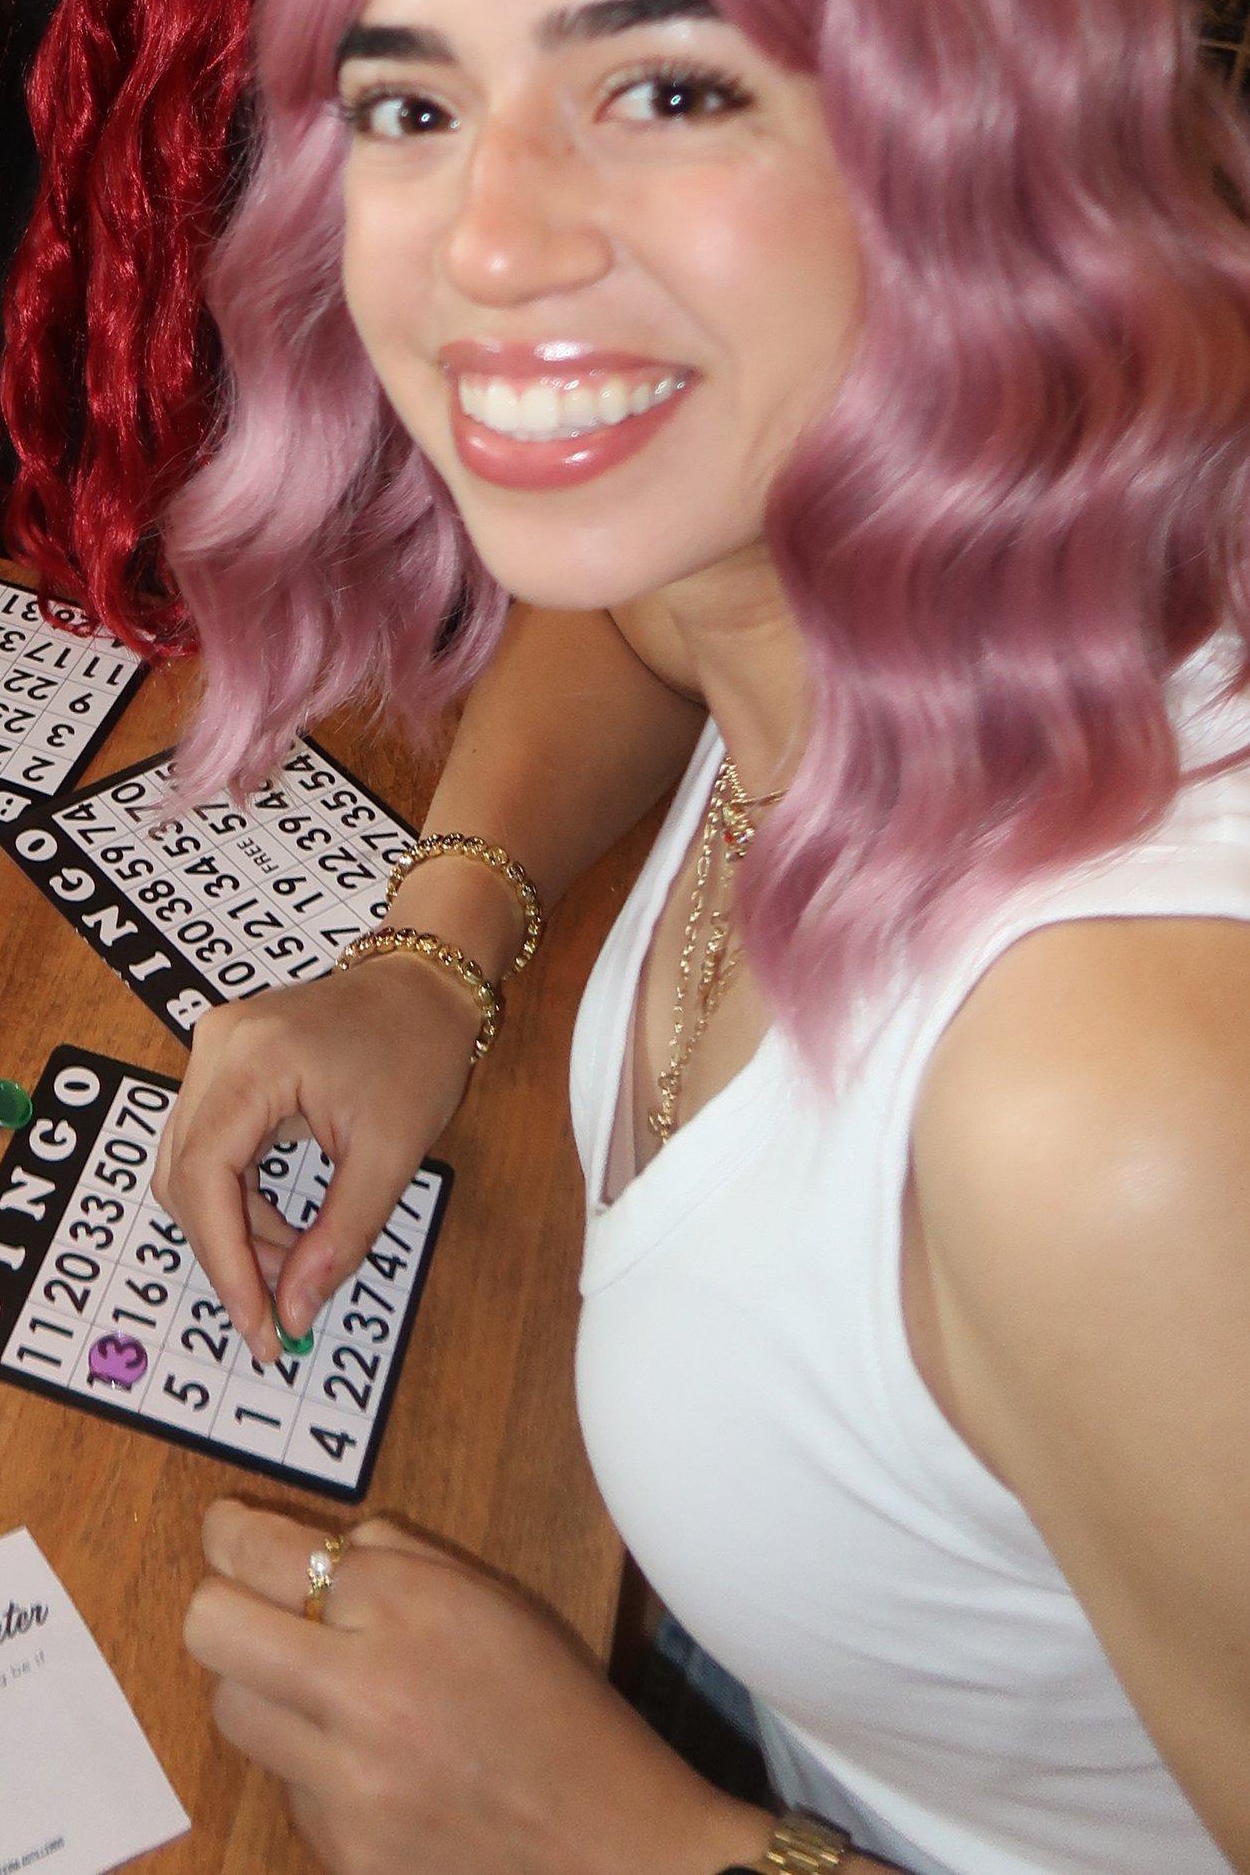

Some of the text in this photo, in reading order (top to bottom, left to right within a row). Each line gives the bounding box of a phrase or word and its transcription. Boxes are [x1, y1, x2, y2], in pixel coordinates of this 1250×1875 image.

[22, 641, 72, 670] 17
[81, 655, 124, 686] 11
[2, 668, 59, 701] 22
[67, 692, 93, 714] 9
[45, 723, 75, 748] 3
[21, 755, 55, 782] 2
[279, 753, 336, 792] 54
[60, 802, 117, 845] 74
[191, 803, 247, 835] 57
[319, 790, 376, 828] 35
[276, 816, 332, 851] 39
[99, 845, 154, 881] 59
[235, 838, 279, 874] FREE
[317, 846, 377, 890] 22
[110, 781, 320, 979] 15 21 34 53 70
[271, 876, 324, 913] 19
[136, 879, 193, 922] 38
[14, 826, 214, 1032] BINGO
[176, 920, 233, 963] 30
[319, 927, 361, 948] 7
[15, 1086, 170, 1367] 11 20 33 50 70
[85, 1220, 188, 1392] 13 16 36
[337, 1271, 395, 1343] 37
[179, 1300, 233, 1363] 23
[162, 1375, 210, 1410] 5
[322, 1346, 381, 1411] 22
[233, 1407, 281, 1427] 1
[308, 1426, 356, 1460] 4
